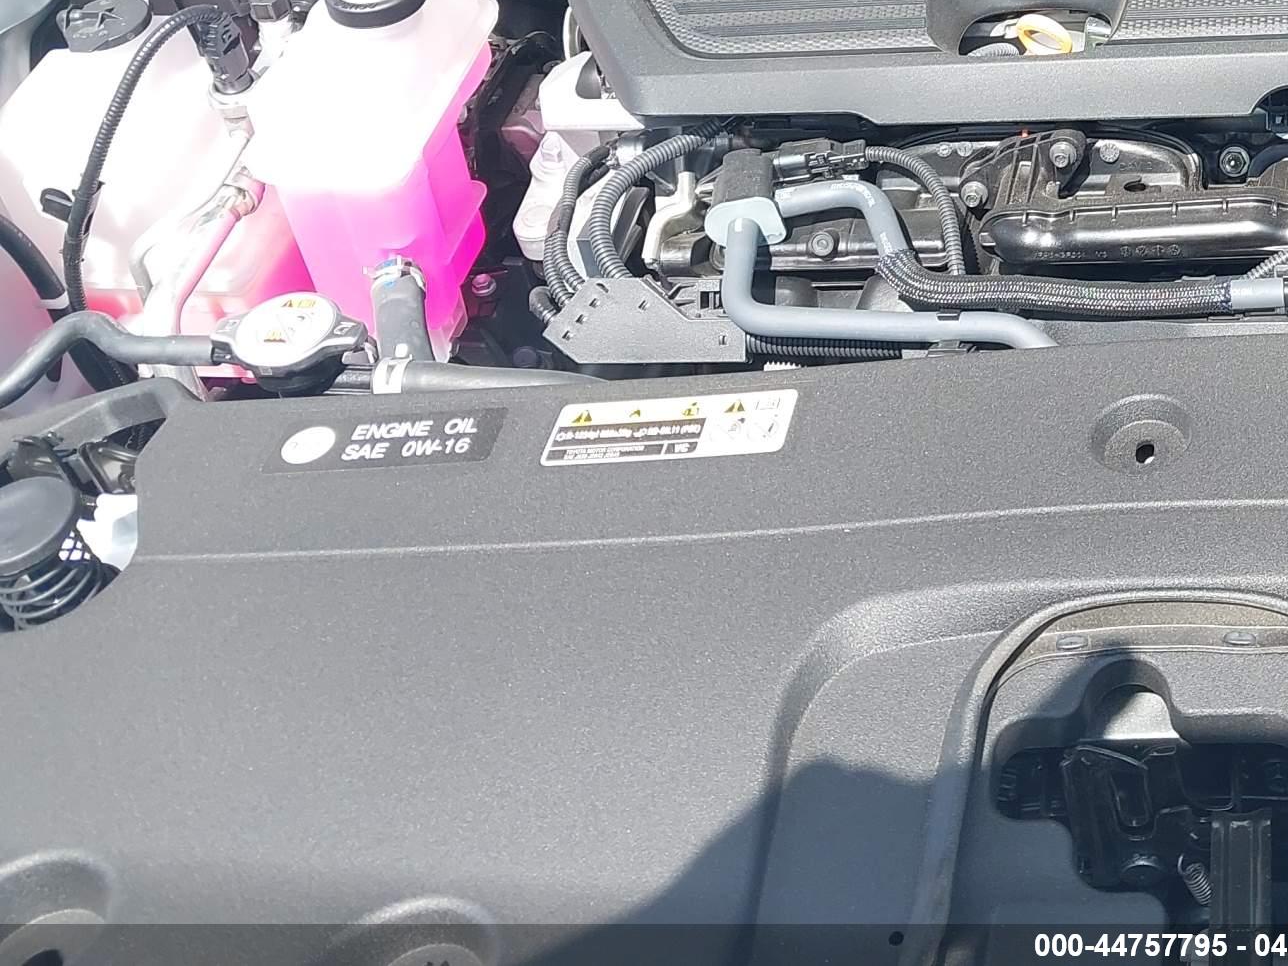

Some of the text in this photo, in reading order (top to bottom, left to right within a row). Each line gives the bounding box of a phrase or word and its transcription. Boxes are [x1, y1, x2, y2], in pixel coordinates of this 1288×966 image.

[351, 417, 478, 441] ENGINE OIL
[341, 437, 471, 461] SAE 0W-16
